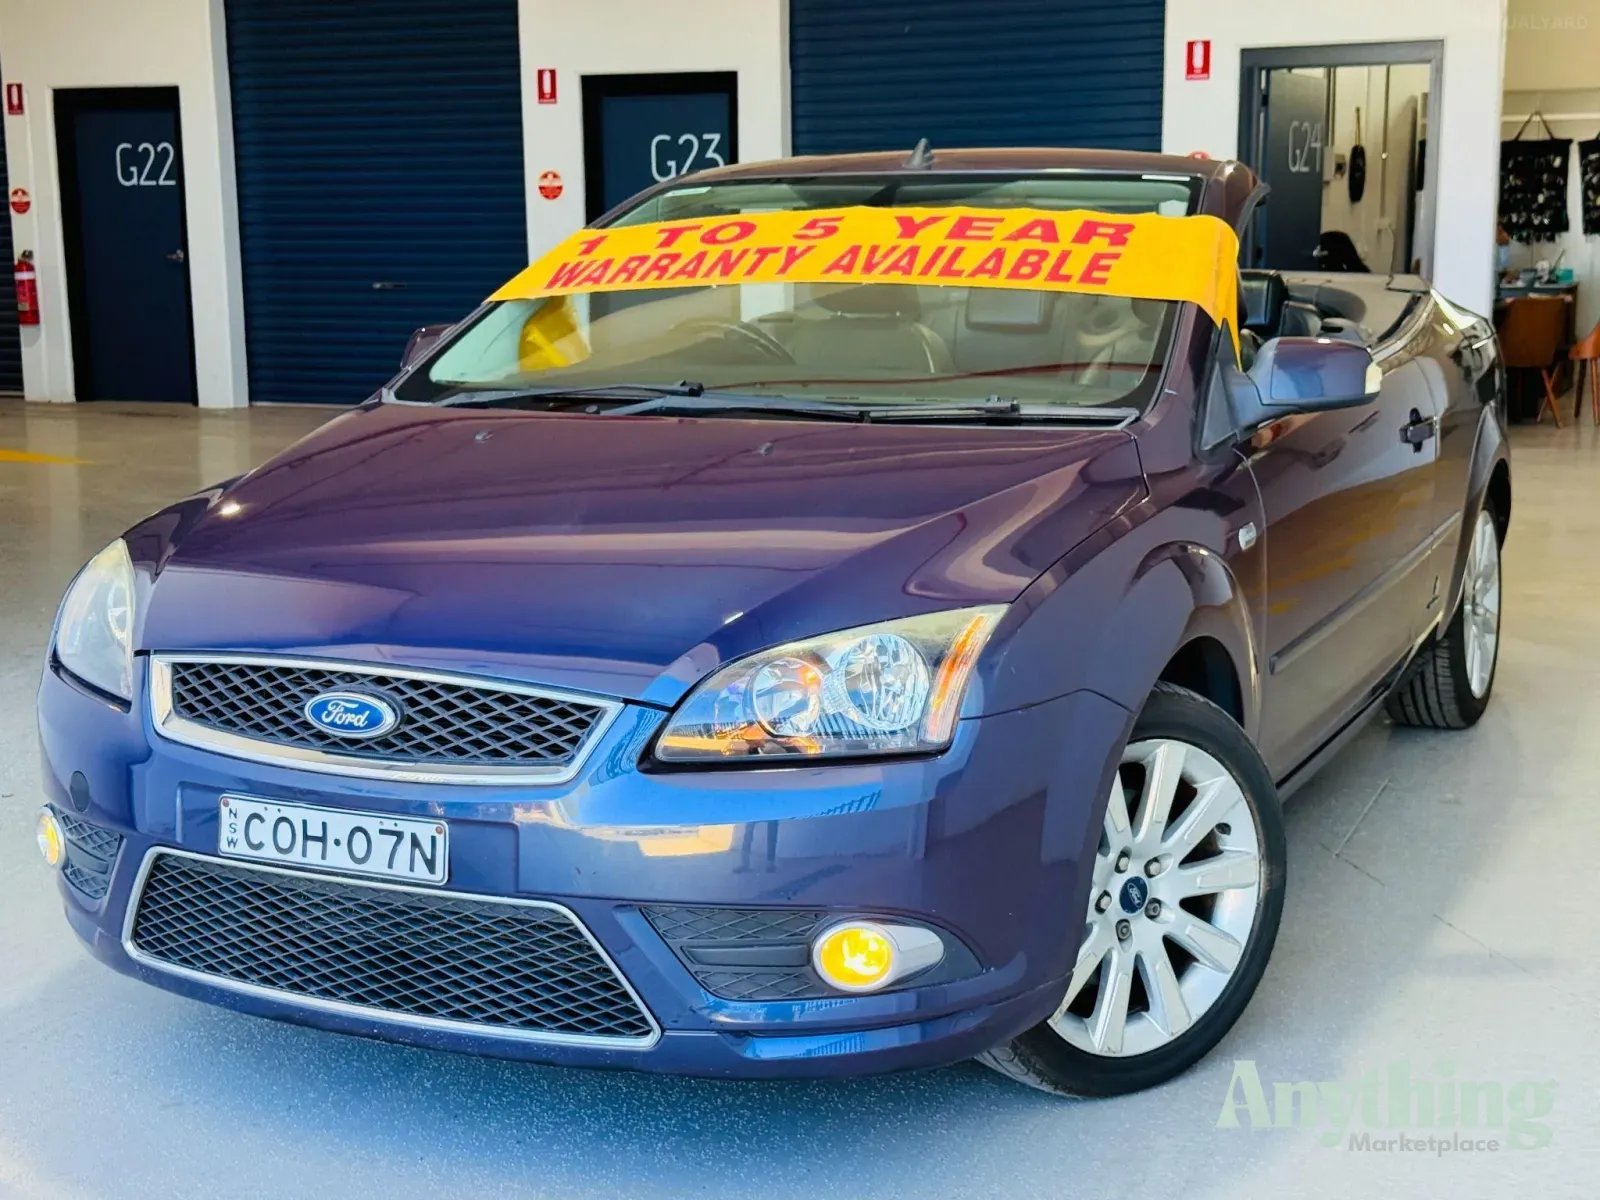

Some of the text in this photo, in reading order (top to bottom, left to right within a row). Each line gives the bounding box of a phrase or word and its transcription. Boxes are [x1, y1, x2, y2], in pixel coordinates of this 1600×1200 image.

[116, 142, 176, 187] G22
[651, 133, 725, 183] G23
[1289, 120, 1321, 173] G24
[578, 215, 1136, 256] 1 TO 5 YEAR
[544, 245, 1122, 290] WARRANTY AVAILABLE
[321, 700, 370, 728] Ford
